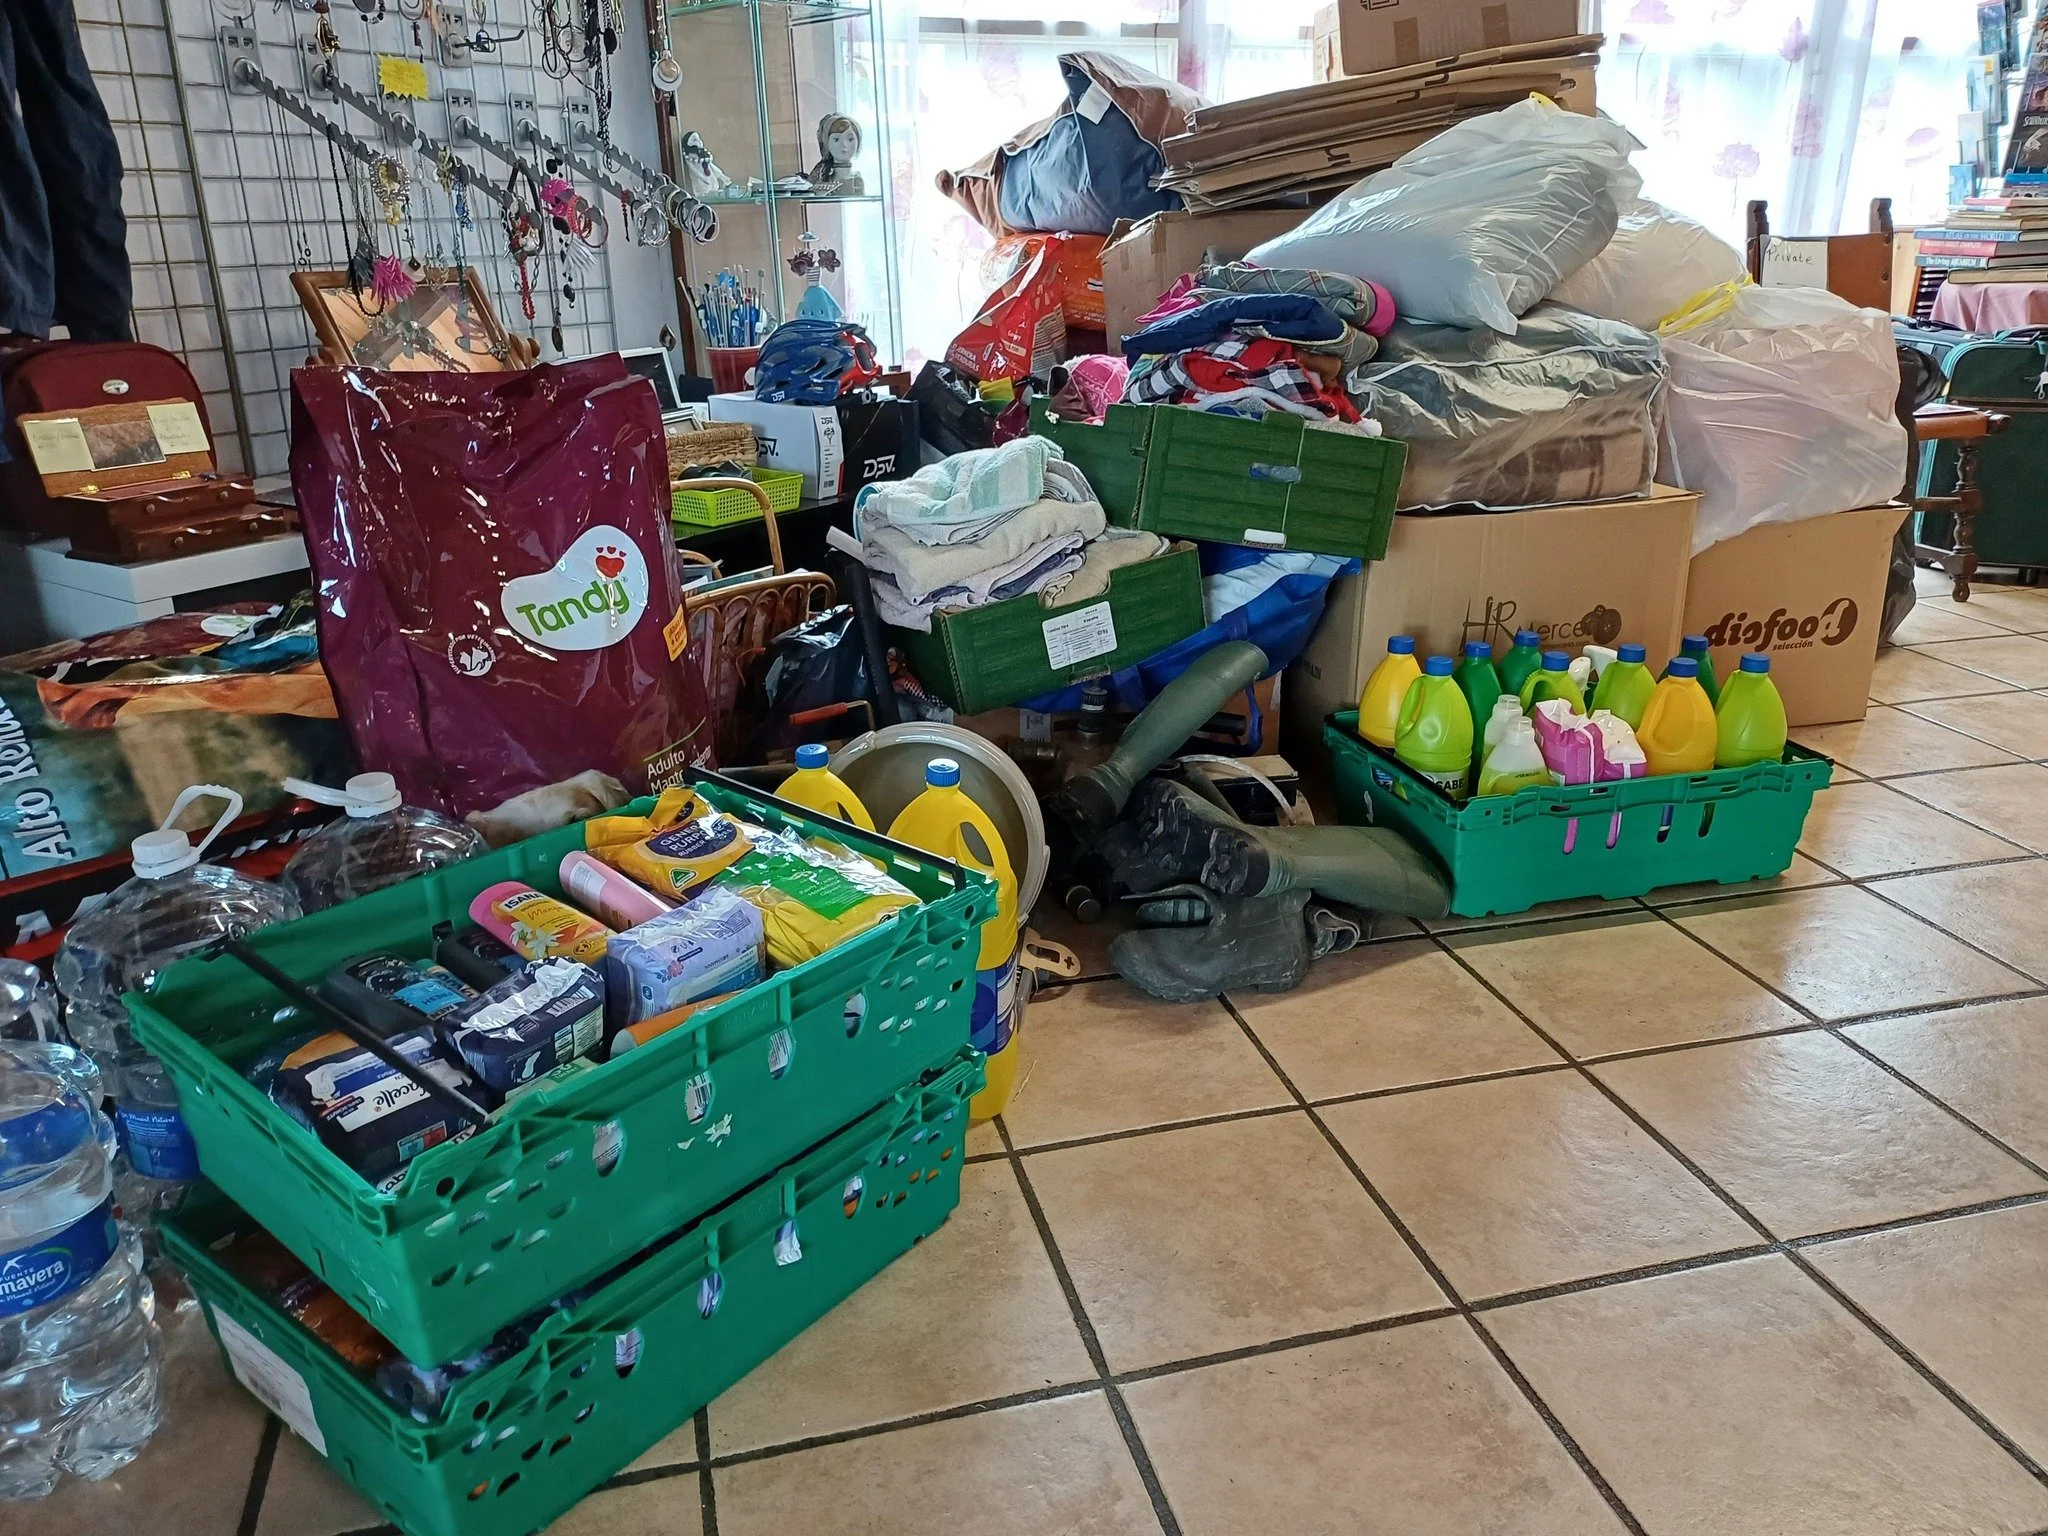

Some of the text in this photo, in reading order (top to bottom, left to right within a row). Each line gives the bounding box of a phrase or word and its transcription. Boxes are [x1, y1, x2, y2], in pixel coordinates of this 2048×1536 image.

[1766, 244, 1813, 266] Private
[515, 579, 630, 637] Tandy
[1772, 639, 1814, 651] selección
[647, 749, 686, 780] Adulto
[13, 789, 72, 860] Alto
[678, 840, 706, 856] RUBBER
[0, 1260, 65, 1296] mavera
